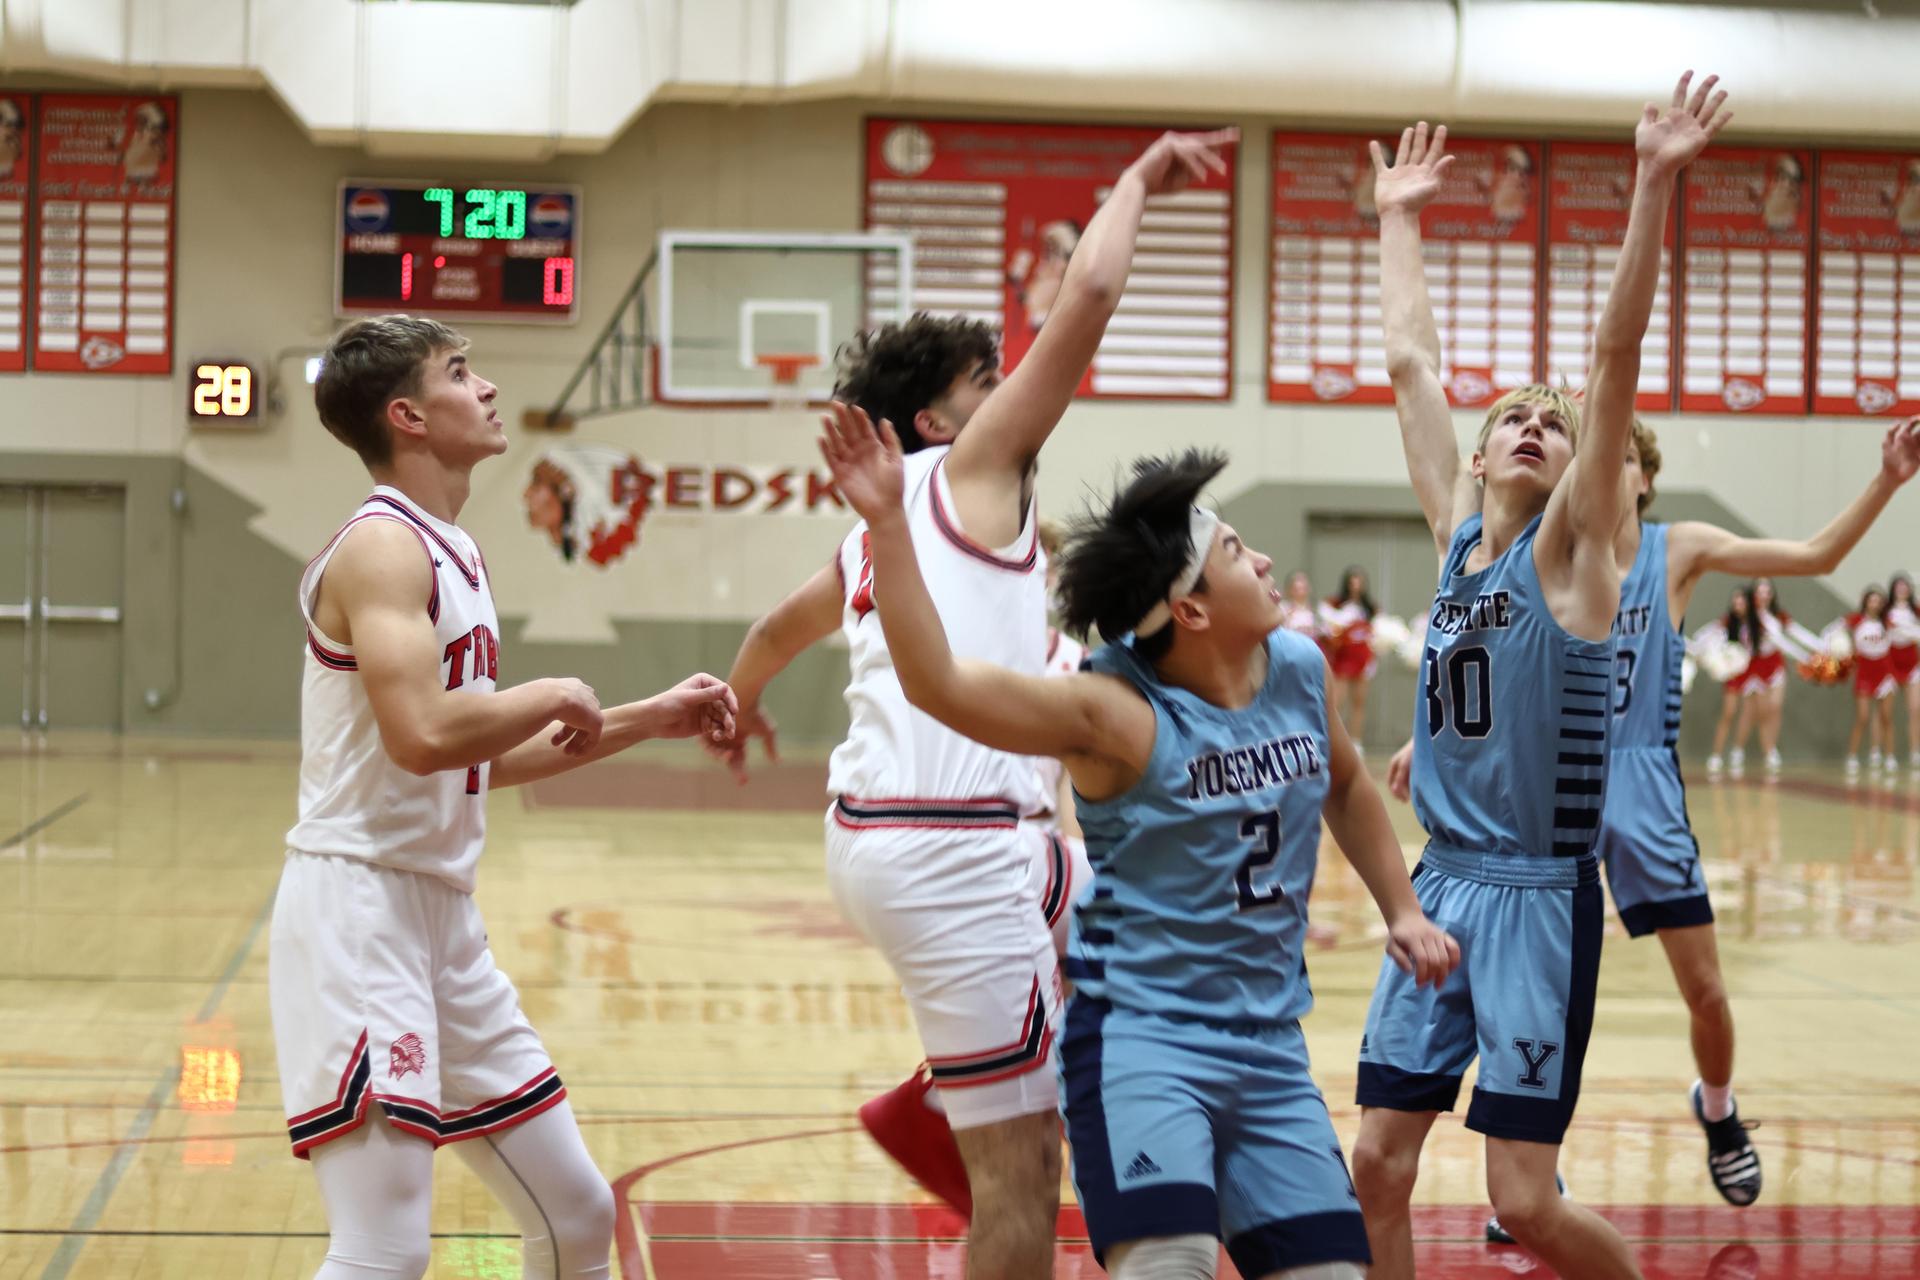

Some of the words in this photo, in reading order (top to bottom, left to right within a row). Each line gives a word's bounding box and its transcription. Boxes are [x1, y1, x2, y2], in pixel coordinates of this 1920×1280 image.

[400, 252, 413, 301] 1
[543, 256, 574, 306] 0
[194, 365, 252, 417] 28
[610, 464, 846, 511] REDSK
[1186, 732, 1322, 804] YOSEMITE
[1235, 807, 1285, 911] 2
[1512, 1036, 1560, 1090] Y
